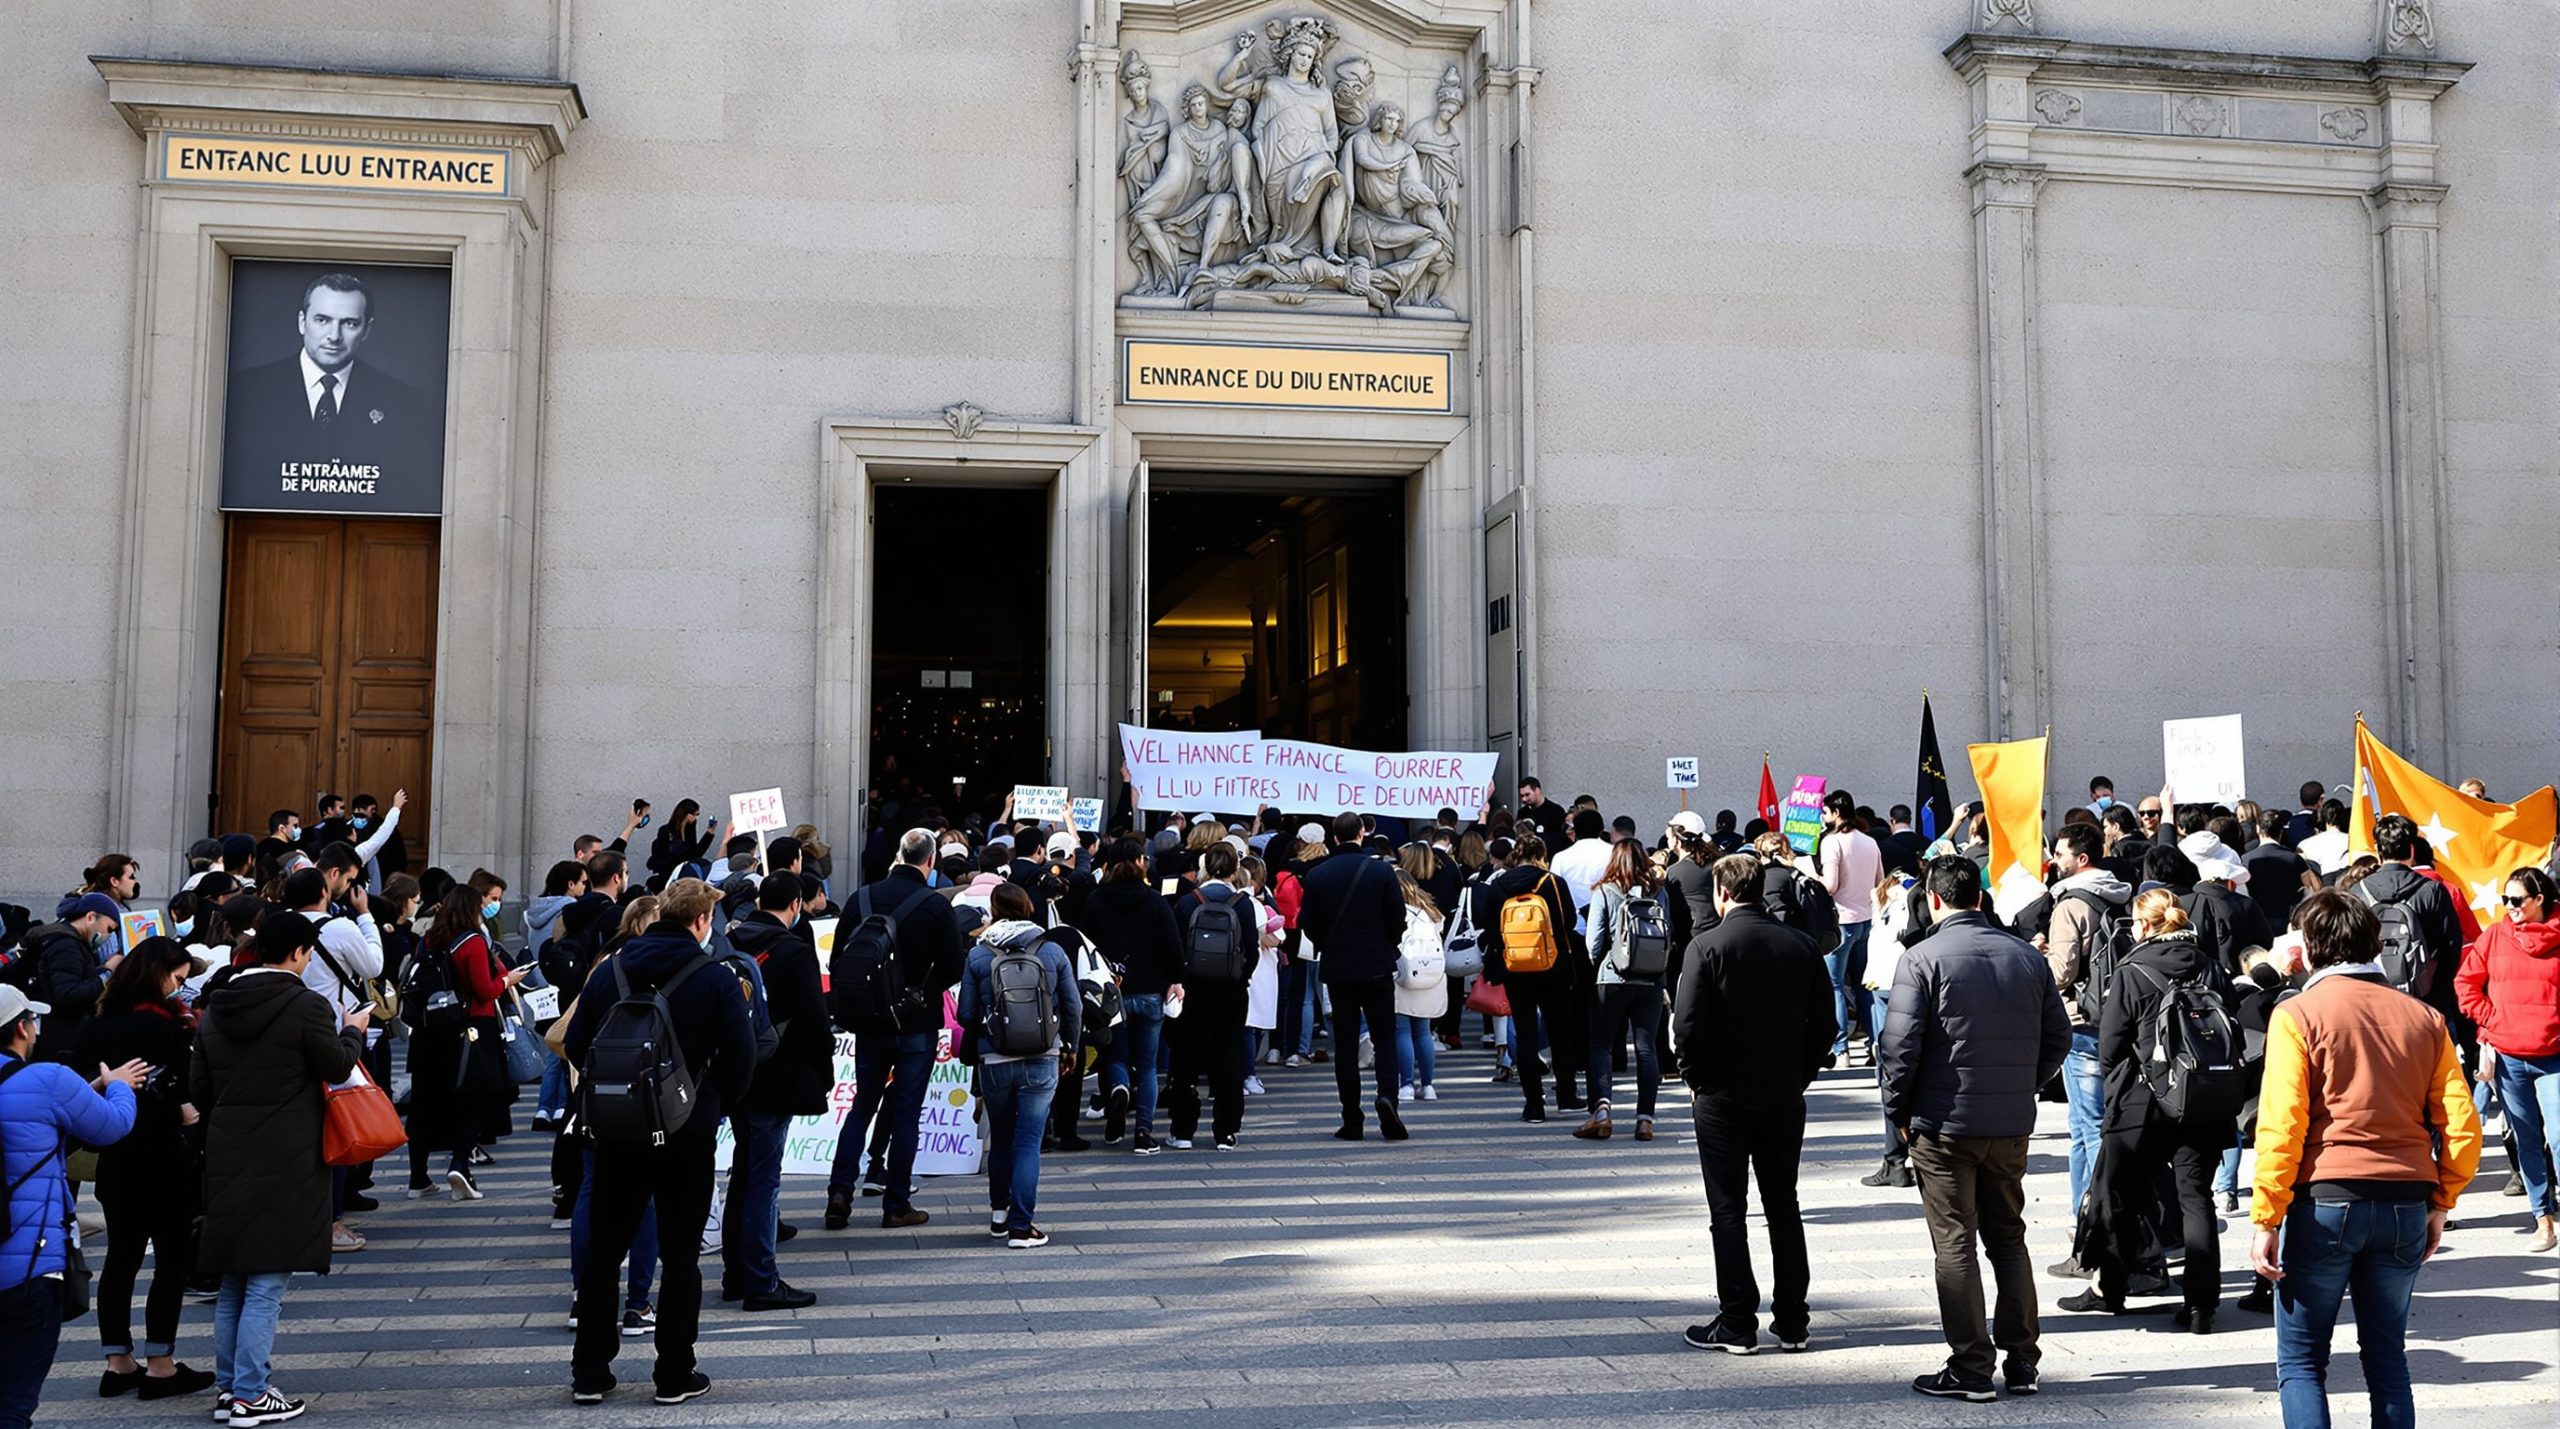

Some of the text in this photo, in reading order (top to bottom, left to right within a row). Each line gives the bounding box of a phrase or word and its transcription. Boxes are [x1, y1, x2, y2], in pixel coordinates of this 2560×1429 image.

[300, 153, 351, 177] LUU
[361, 156, 494, 184] ENTRANCE
[1140, 366, 1434, 394] ENNRANCE DU DIU ENTRACIUE
[281, 462, 299, 477] LE
[281, 478, 376, 494] DE PURRANCE
[1129, 738, 1170, 764] VEL
[1177, 742, 1255, 765] HANNCE
[1297, 782, 1318, 801] IN
[1338, 783, 1366, 806] DE
